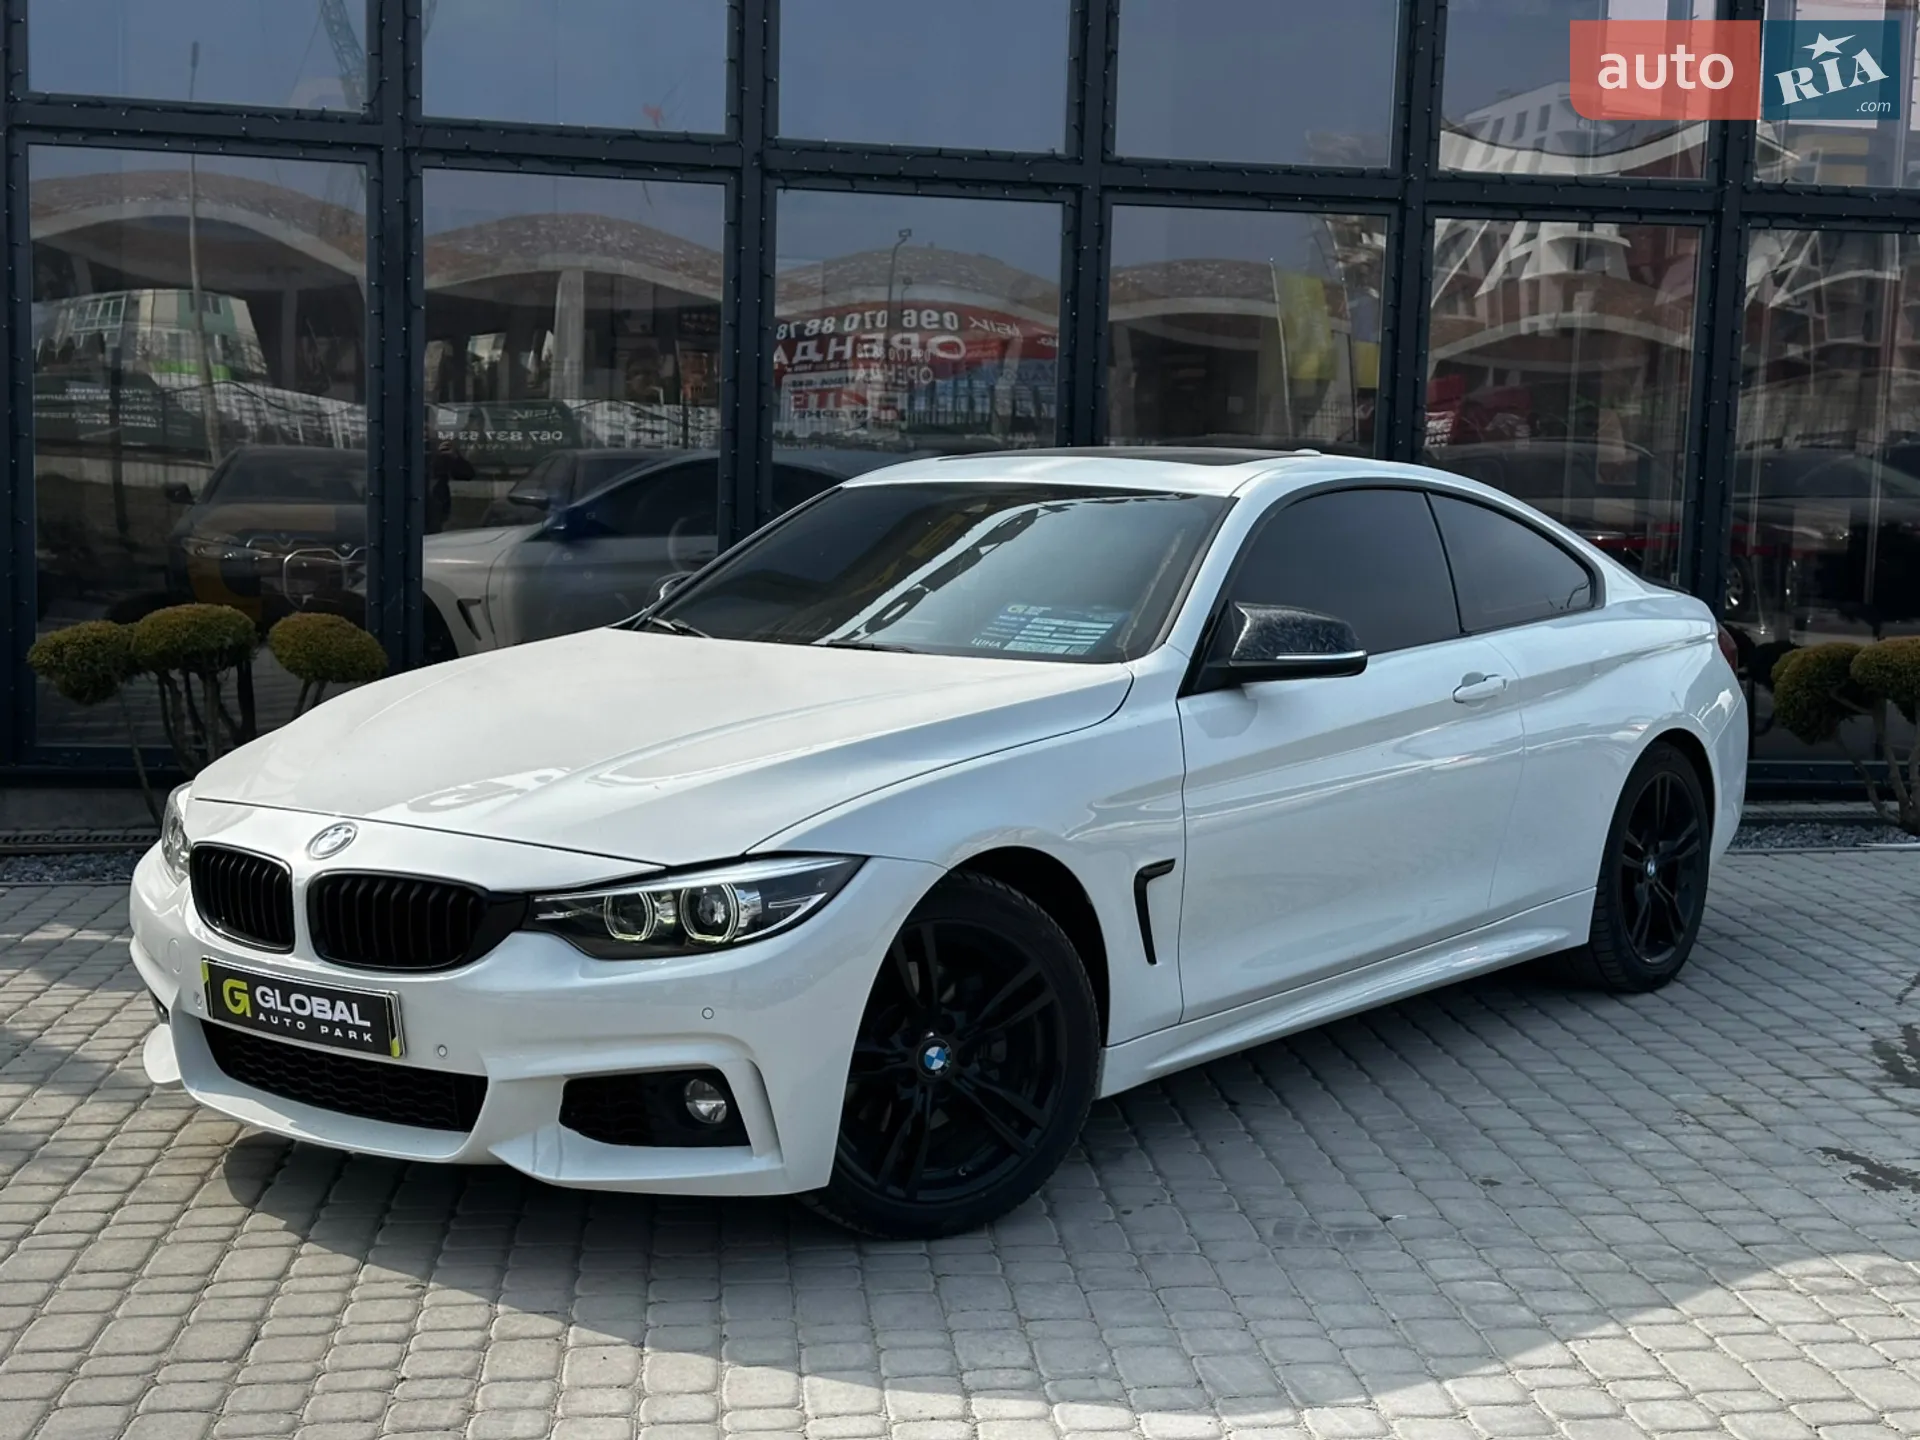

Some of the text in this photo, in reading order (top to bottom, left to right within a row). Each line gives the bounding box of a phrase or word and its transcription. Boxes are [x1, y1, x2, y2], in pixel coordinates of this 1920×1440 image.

[254, 985, 371, 1028] GLOBAL
[258, 1012, 373, 1043] AUTO PARK
